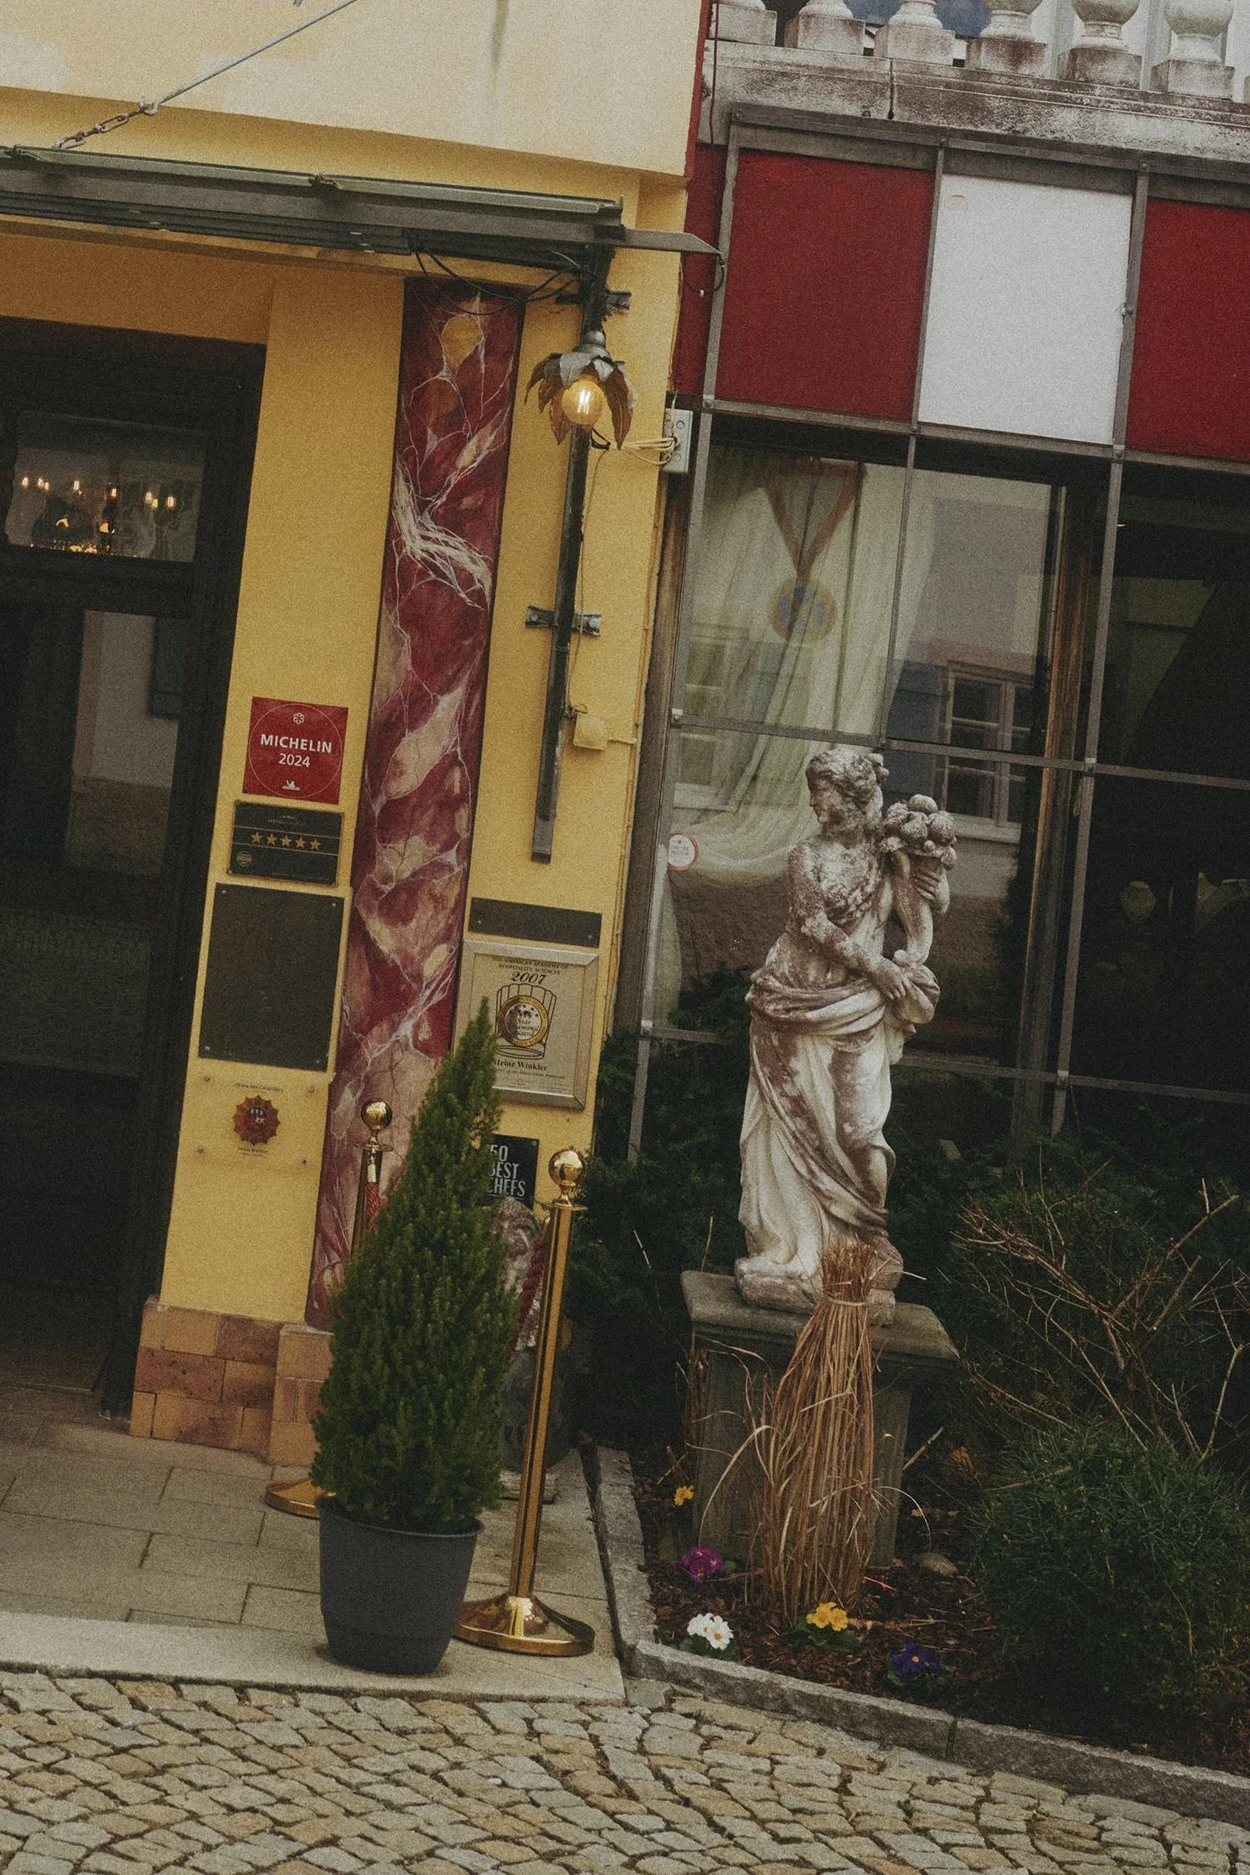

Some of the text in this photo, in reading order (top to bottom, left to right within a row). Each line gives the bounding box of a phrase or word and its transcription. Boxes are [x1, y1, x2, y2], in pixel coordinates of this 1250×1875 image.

[260, 733, 333, 755] MICHELIN
[278, 752, 311, 768] 2024
[498, 963, 533, 972] HOSPITALITY
[510, 971, 547, 985] 2007
[517, 1060, 548, 1071] Winkler
[487, 1177, 527, 1198] HEFS
